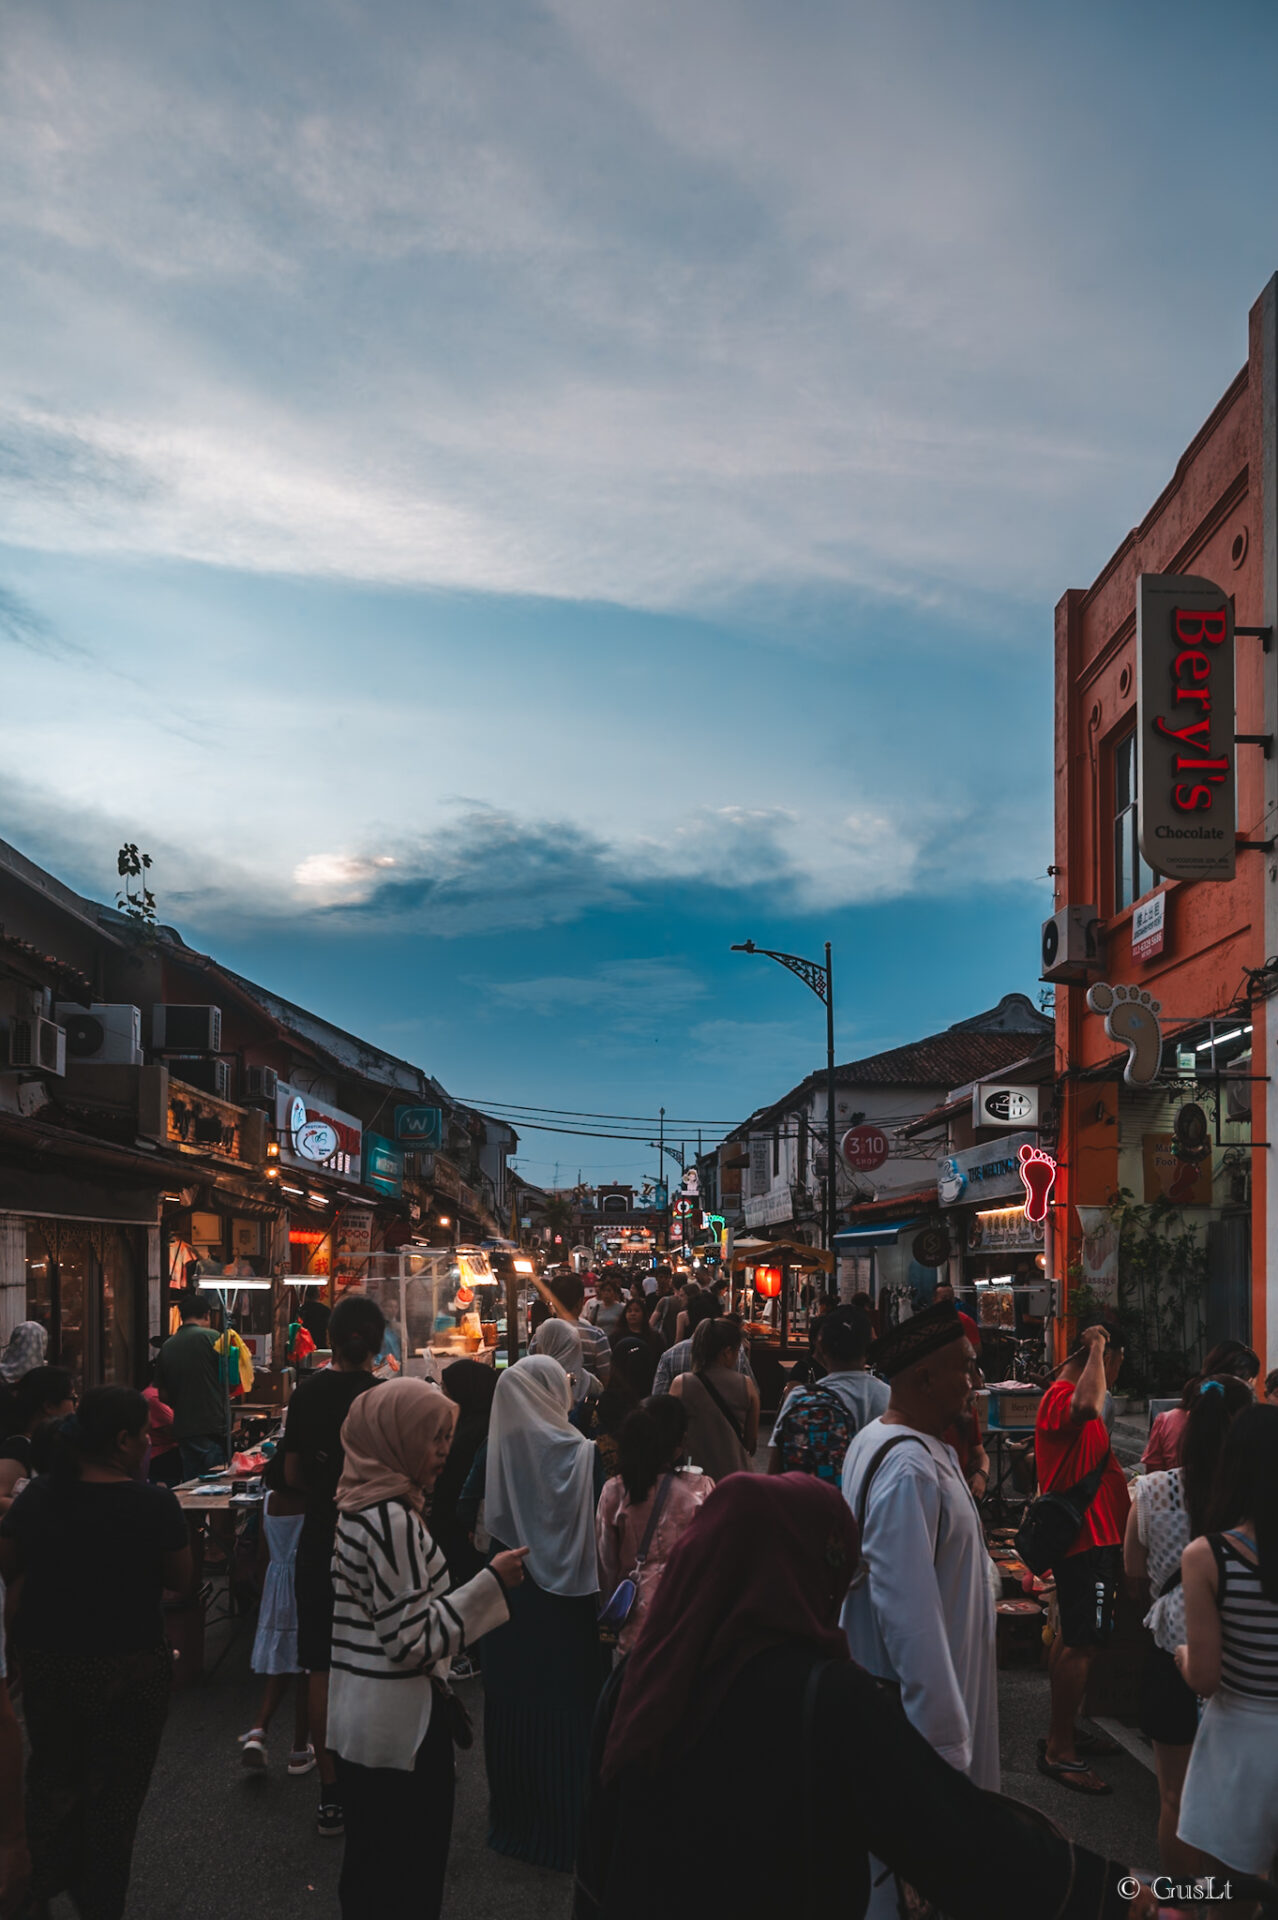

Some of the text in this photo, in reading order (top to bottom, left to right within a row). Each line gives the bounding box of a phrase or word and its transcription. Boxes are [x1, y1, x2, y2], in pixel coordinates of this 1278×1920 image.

[1154, 605, 1231, 814] Beryl's
[1155, 825, 1224, 839] Chocolate
[855, 1158, 878, 1167] SHOP
[1155, 1158, 1177, 1167] Foot
[967, 1166, 983, 1183] THE
